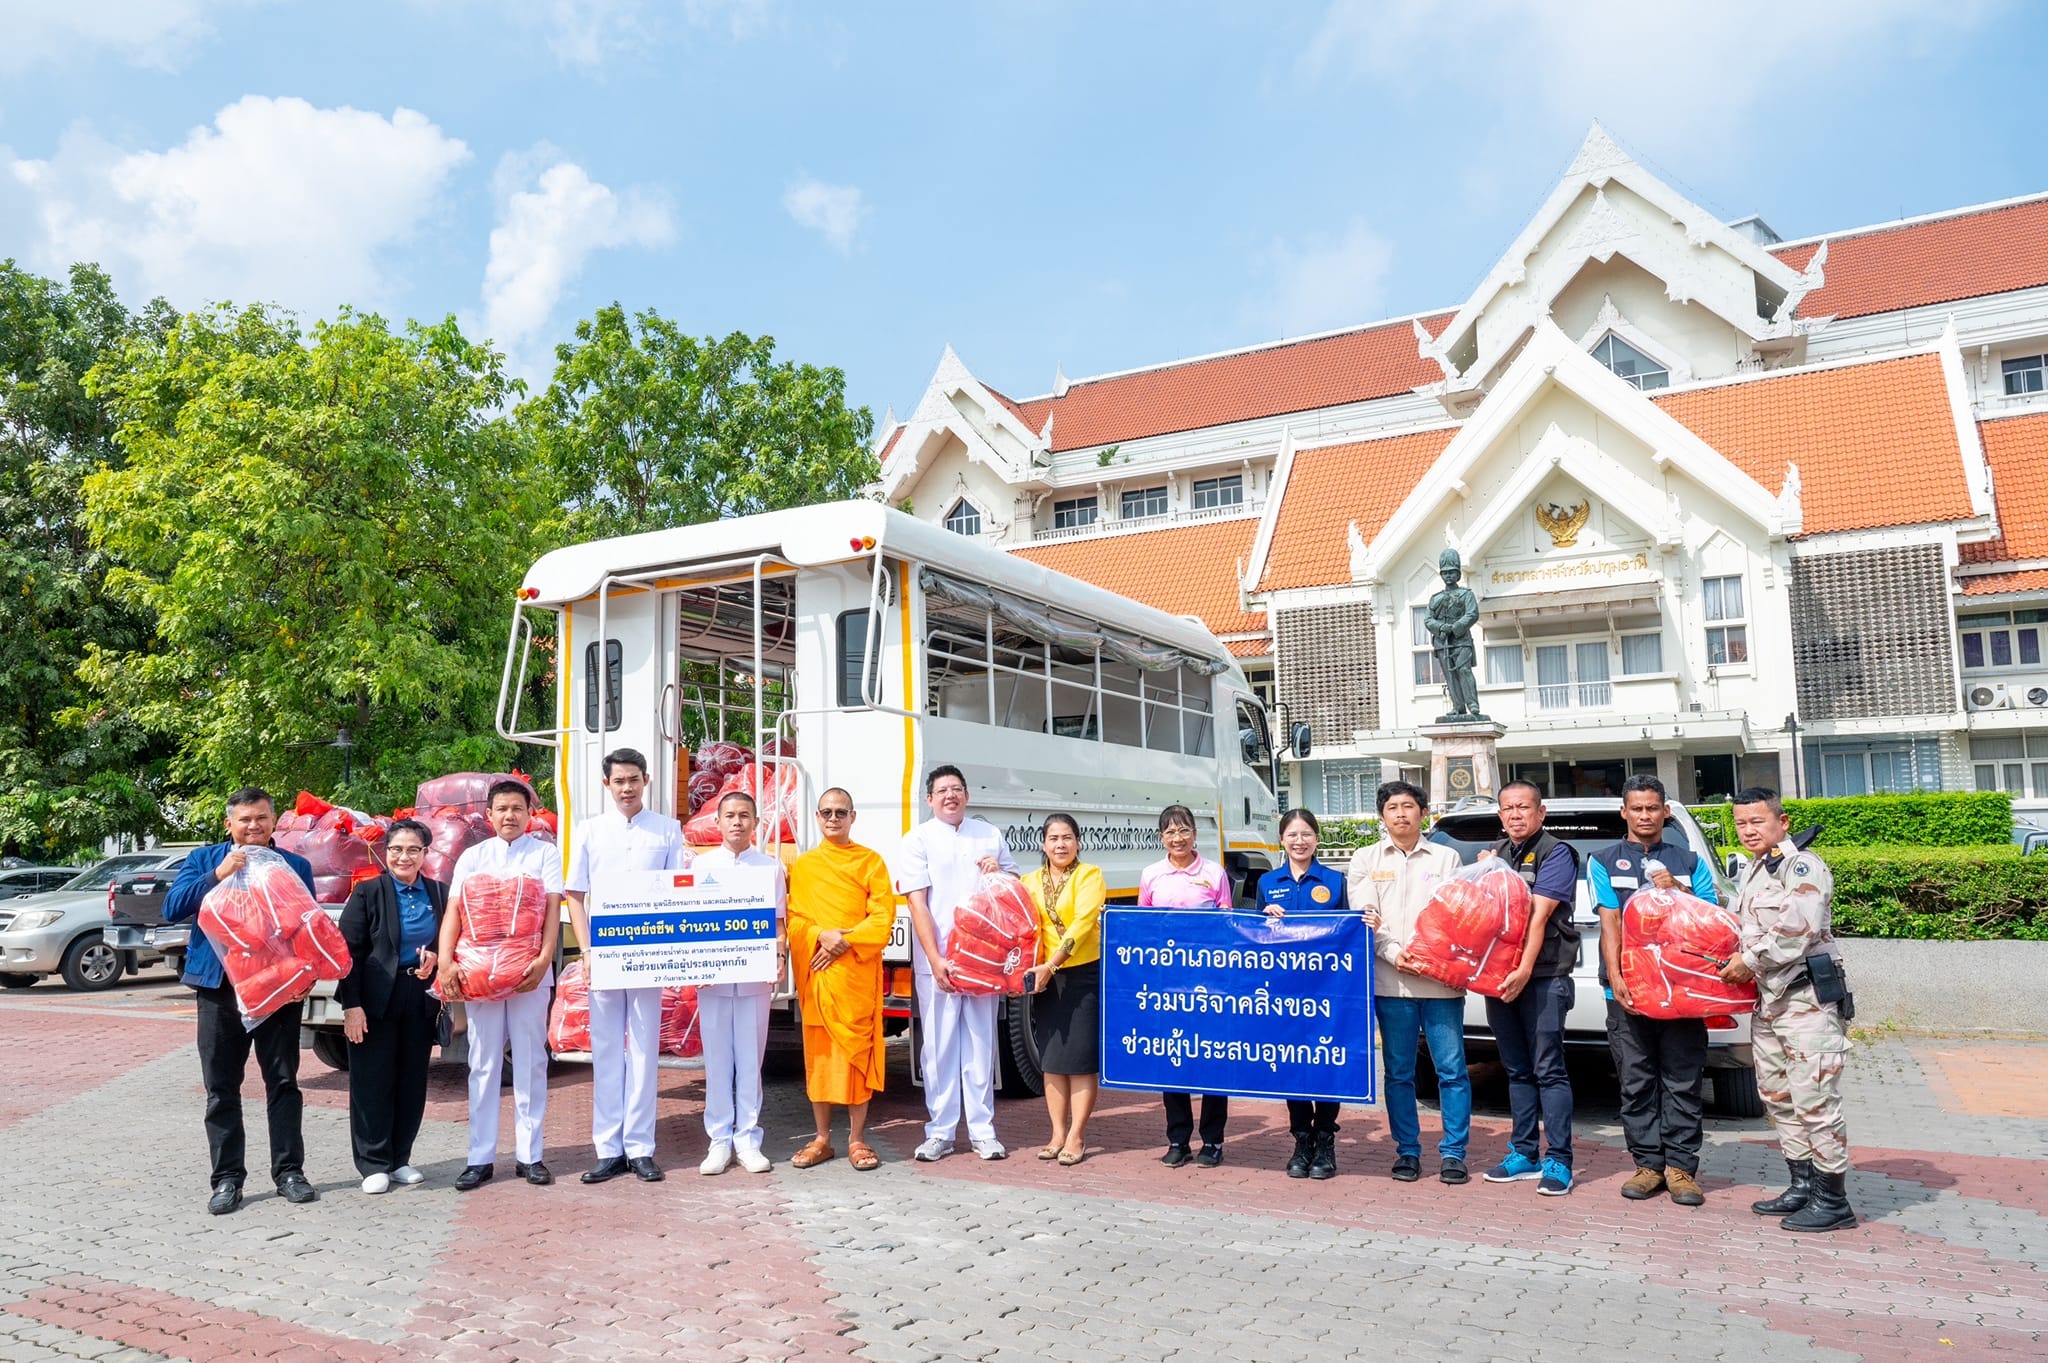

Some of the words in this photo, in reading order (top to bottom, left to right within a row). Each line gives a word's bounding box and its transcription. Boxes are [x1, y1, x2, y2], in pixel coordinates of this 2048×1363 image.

[1492, 552, 1648, 584] ศาลากลางจังหวัดปทุมธานี
[598, 919, 674, 941] มอบถุงยังชีพ
[678, 918, 721, 934] จำนวน
[724, 918, 748, 932] 500
[751, 919, 769, 936] ชุด
[621, 956, 748, 973] เพื่อช่วยเหลือผู้ประสบอุทกภัย
[1116, 938, 1353, 972] ชาวอำเภอคลองหลวง
[1135, 981, 1331, 1018] ร่วมบริจาคสิ่งของ
[1121, 1028, 1347, 1072] ช่วยผู้ประสบอุทกภัย
